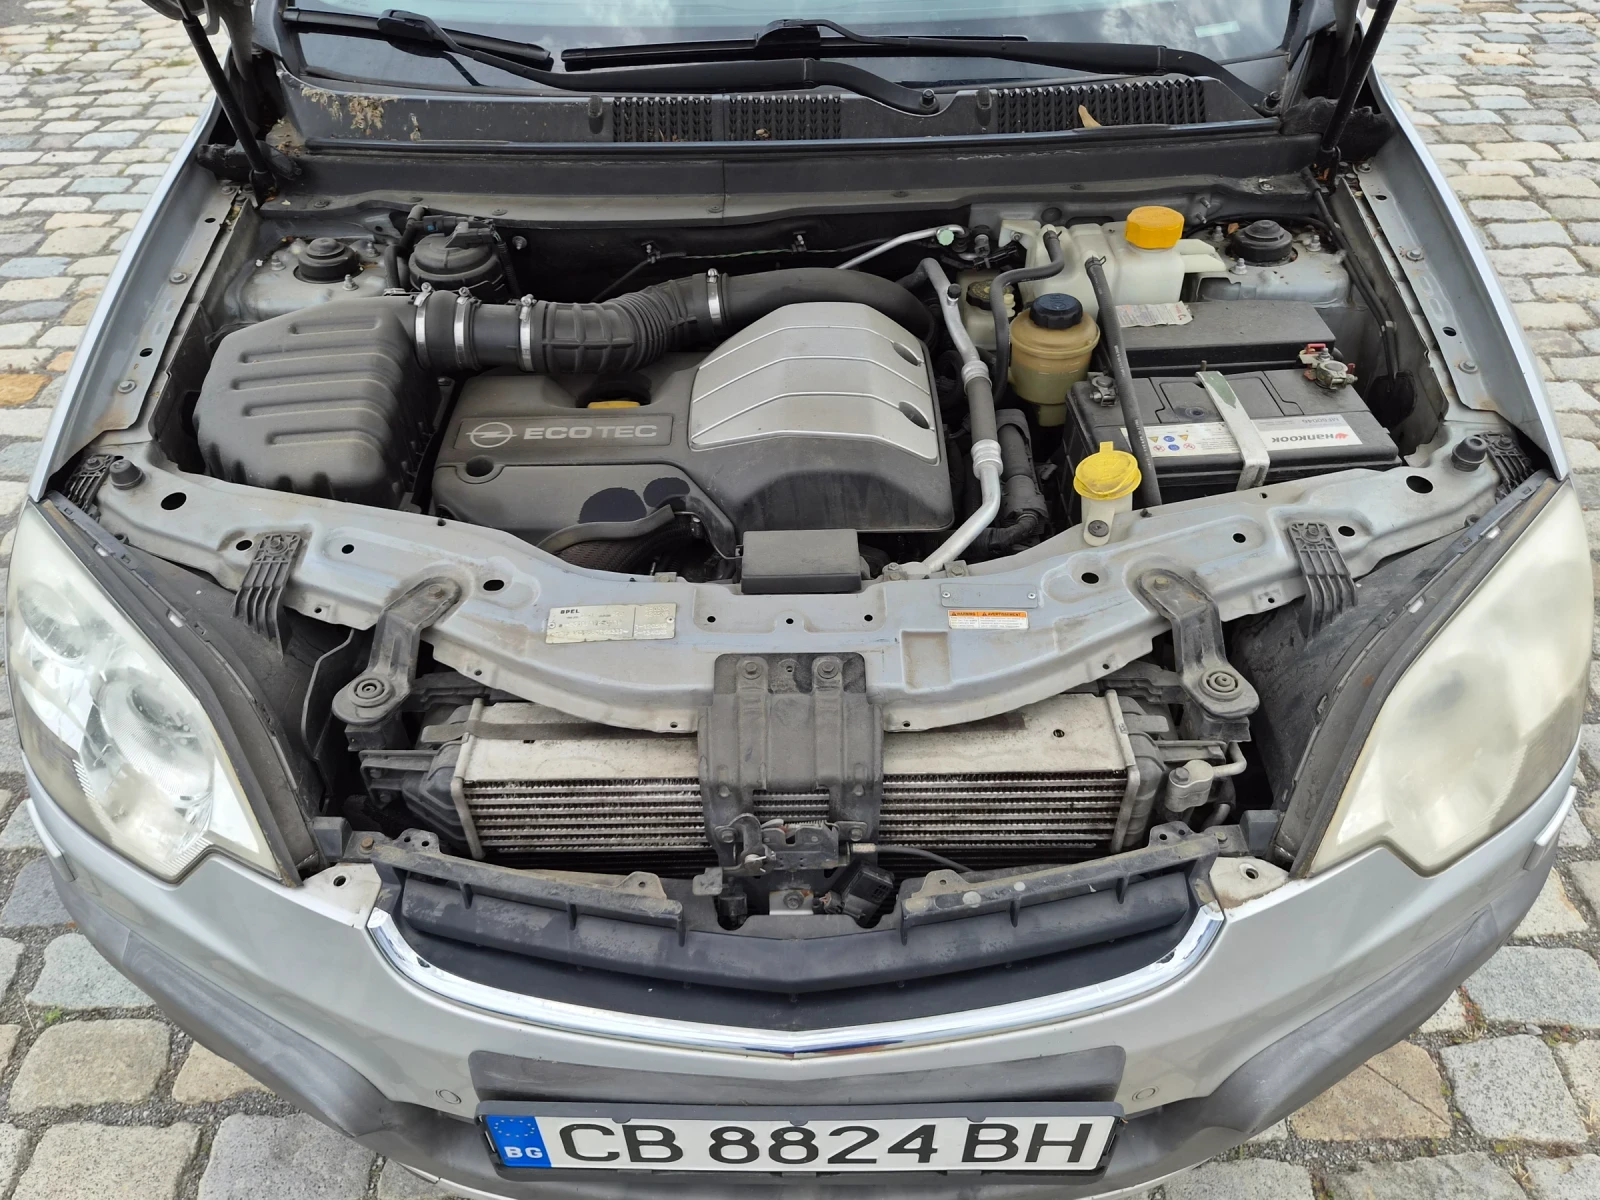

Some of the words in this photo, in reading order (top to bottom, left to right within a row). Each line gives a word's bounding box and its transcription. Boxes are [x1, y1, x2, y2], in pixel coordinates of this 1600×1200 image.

[523, 425, 658, 440] ECOTEC
[558, 1122, 683, 1164] CB
[708, 1124, 939, 1165] 8824
[961, 1122, 1094, 1164] BH
[504, 1145, 544, 1160] BG
